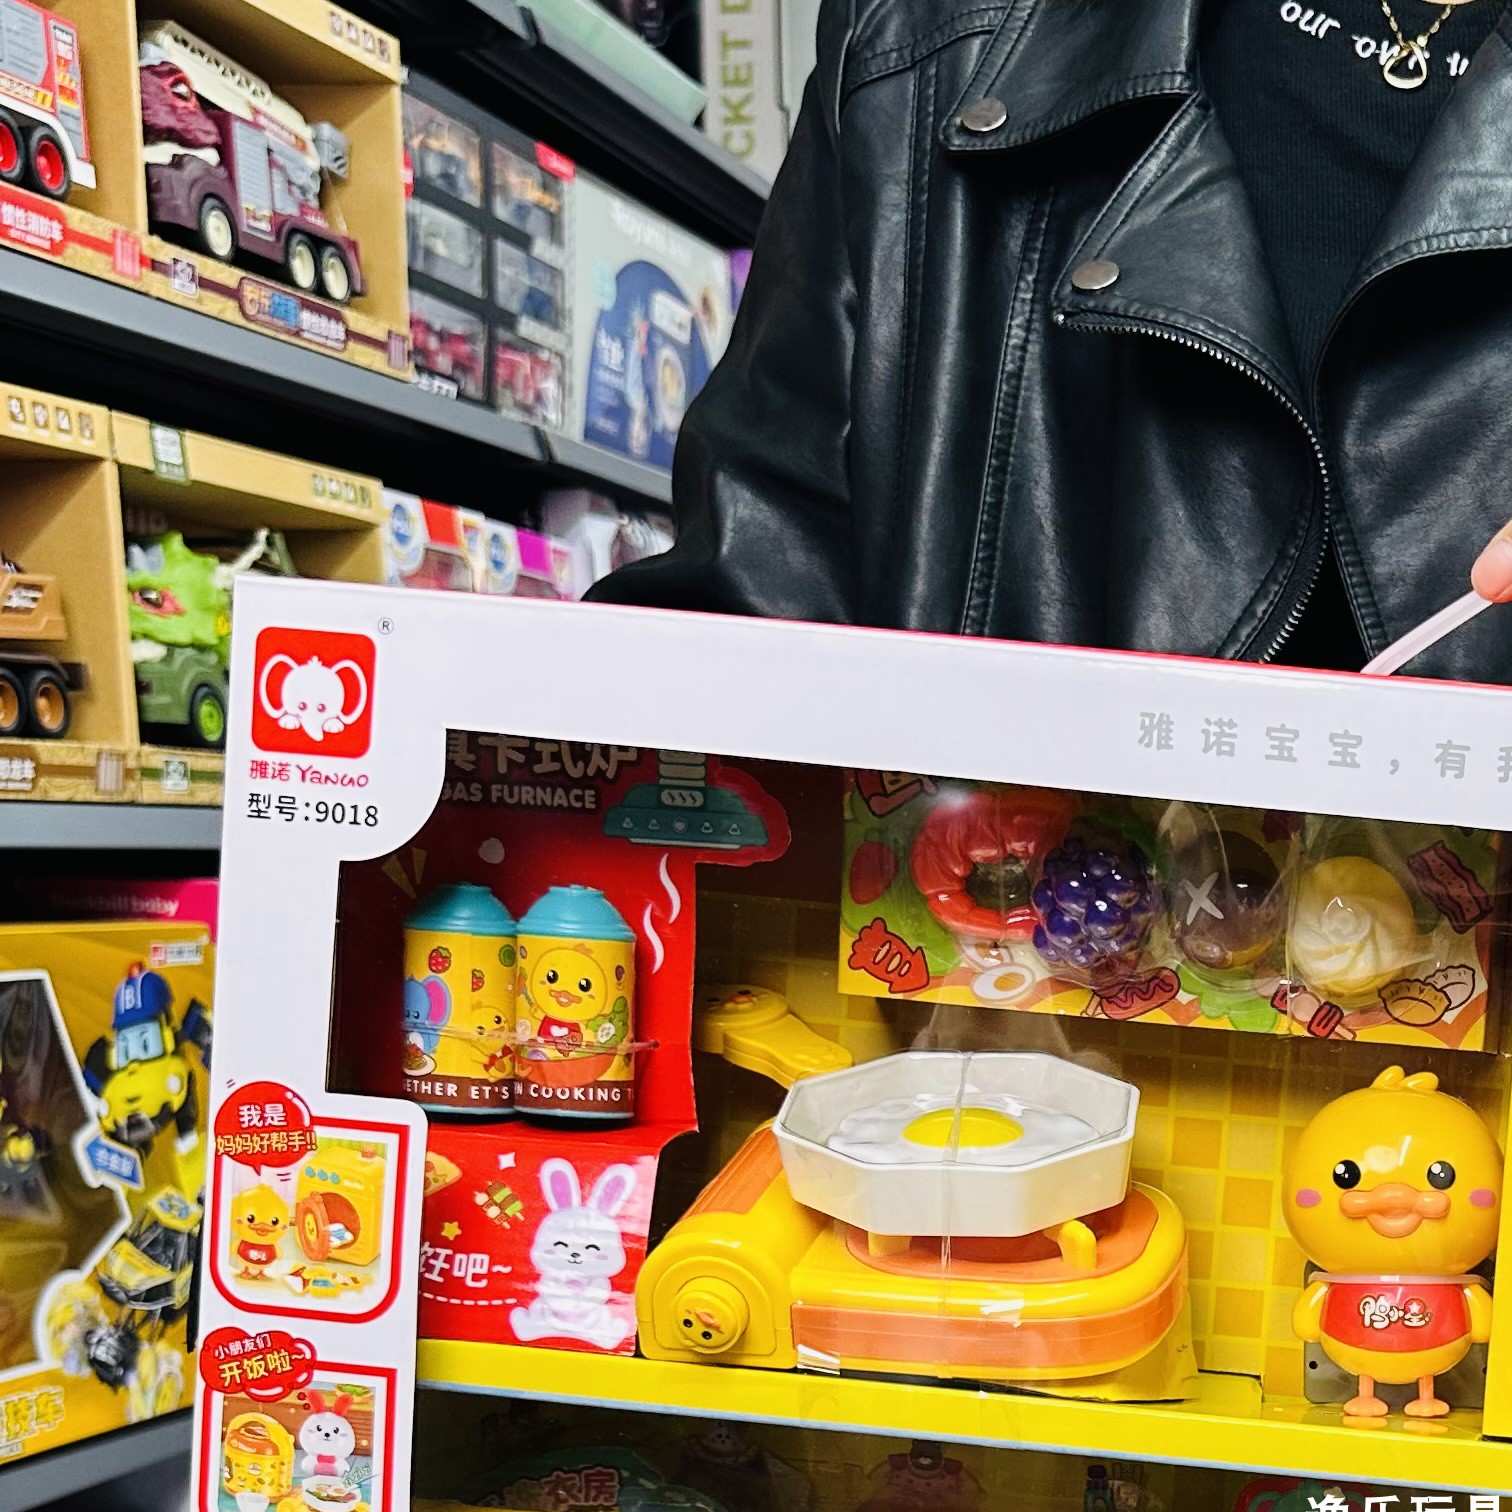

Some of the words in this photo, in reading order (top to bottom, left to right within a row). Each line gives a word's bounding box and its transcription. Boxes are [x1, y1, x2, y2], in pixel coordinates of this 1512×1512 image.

[1281, 1, 1341, 39] our
[249, 759, 290, 782] 雅诺
[491, 784, 597, 809] FURNACE
[247, 792, 380, 828] 型号:9018
[530, 1083, 621, 1102] COOKING
[238, 1103, 288, 1128] 我是
[214, 1333, 272, 1360] 小朋友们
